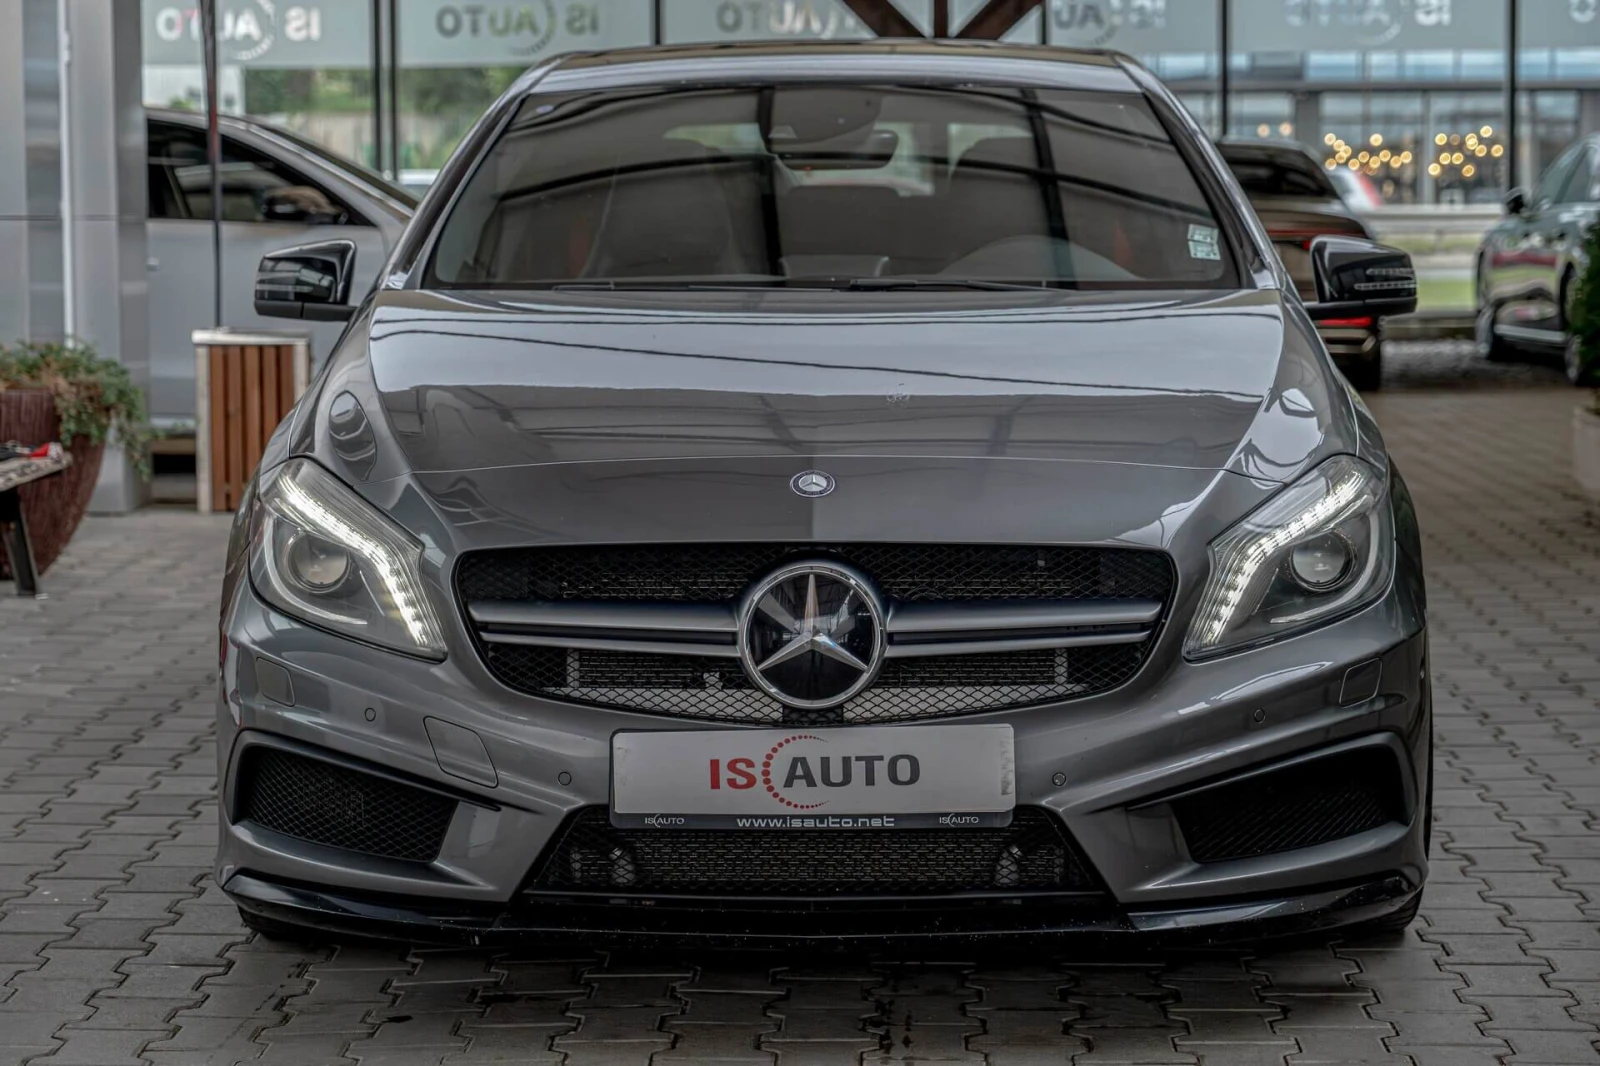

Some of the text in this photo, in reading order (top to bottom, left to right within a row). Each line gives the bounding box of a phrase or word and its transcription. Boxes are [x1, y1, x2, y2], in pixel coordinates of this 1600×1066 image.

[710, 754, 920, 790] IS AUTO
[656, 817, 685, 825] AUTO
[736, 815, 895, 828] www.isauto.net
[951, 816, 979, 824] AUTO
